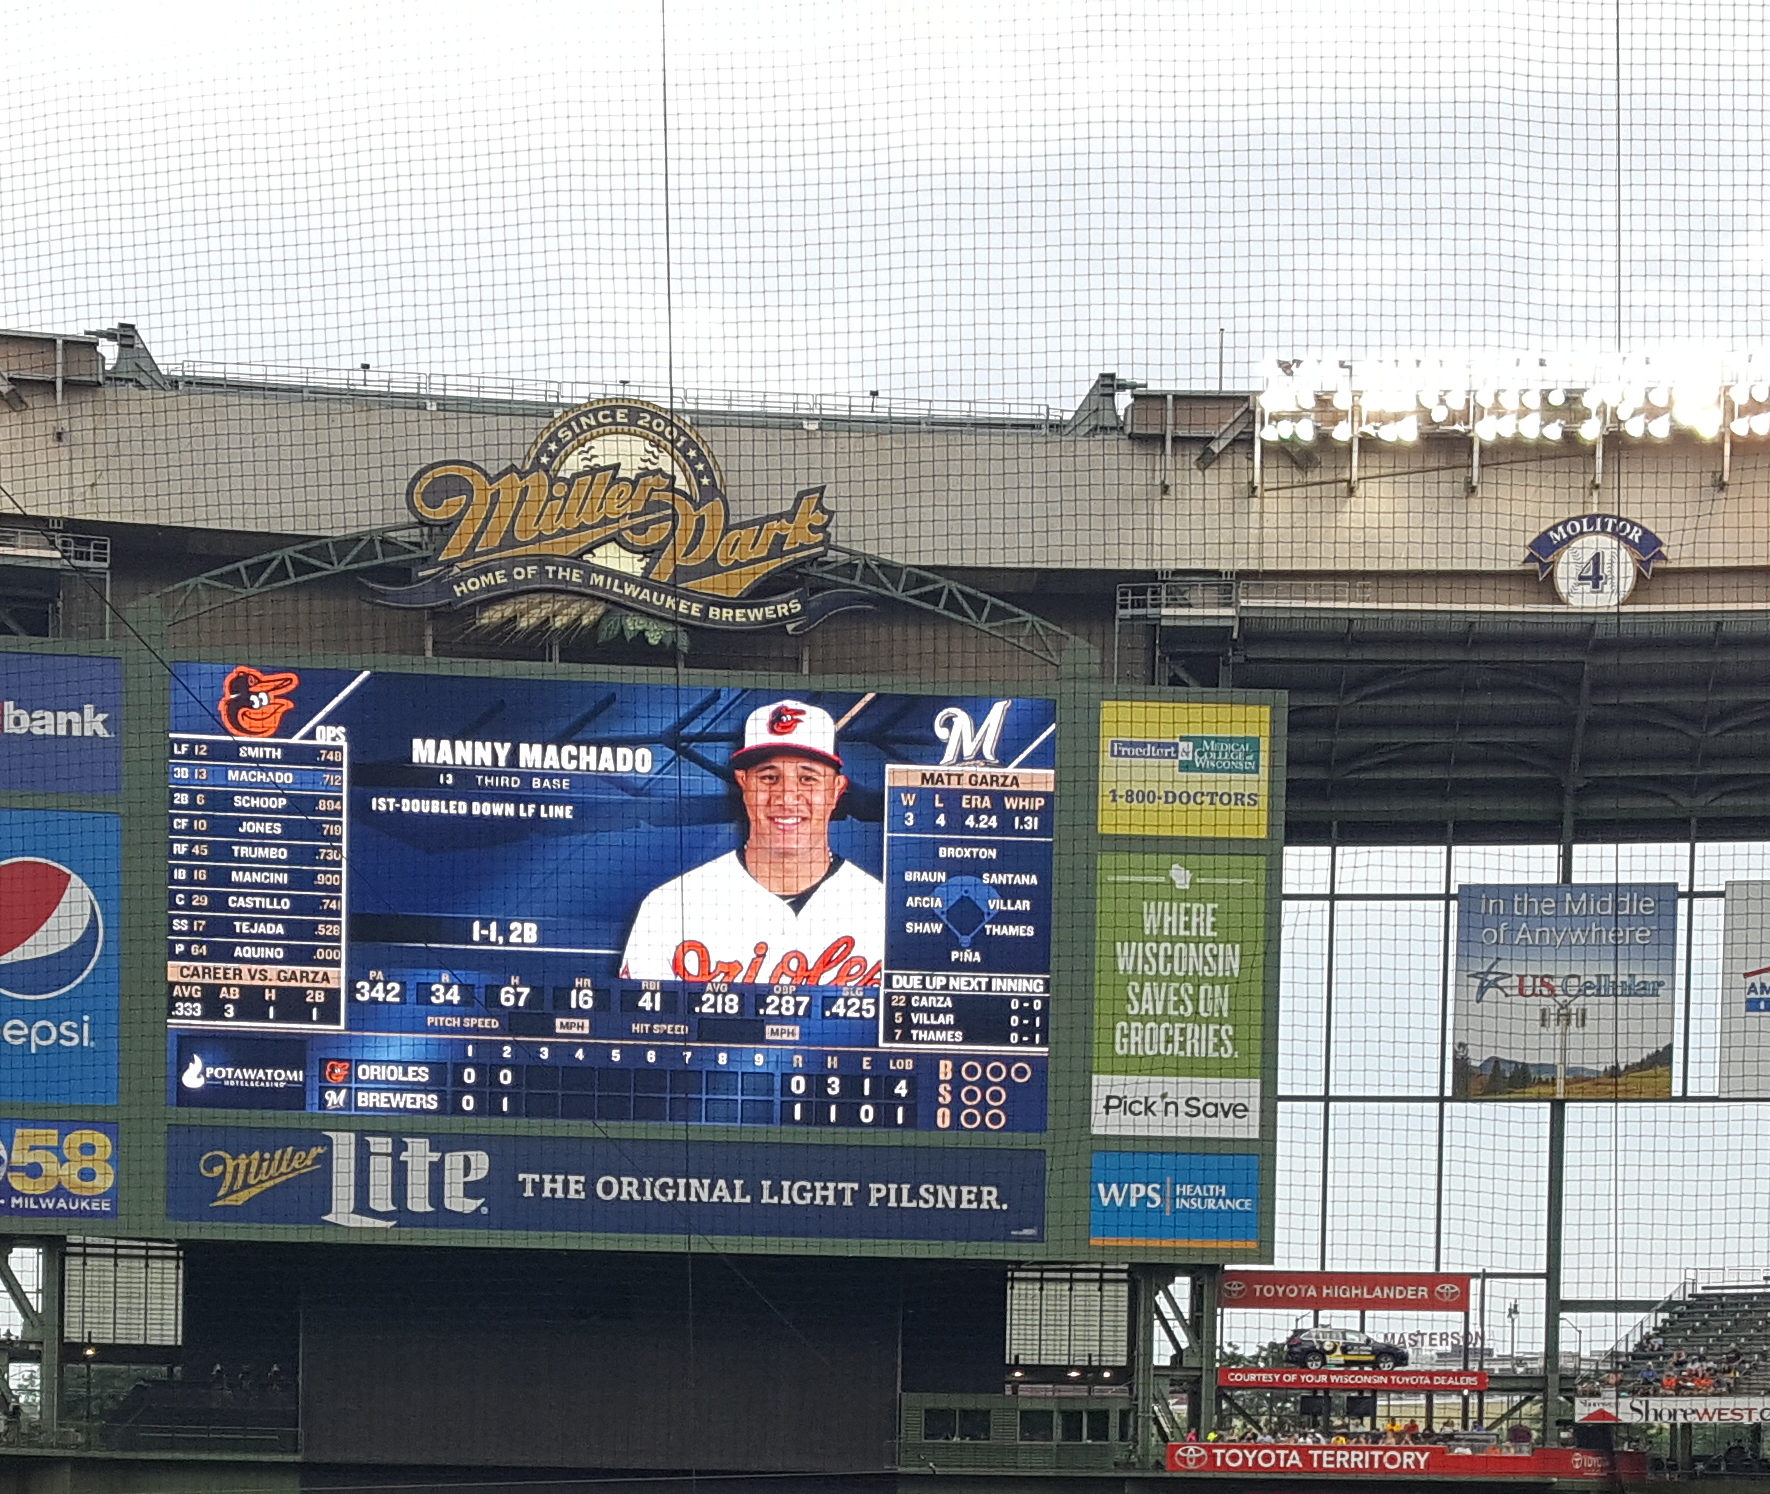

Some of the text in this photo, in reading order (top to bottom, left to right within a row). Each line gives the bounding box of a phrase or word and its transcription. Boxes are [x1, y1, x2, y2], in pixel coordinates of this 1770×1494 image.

[557, 410, 688, 446] SINCE 2001
[413, 463, 827, 598] Miller Park
[1548, 517, 1644, 545] MOLITOR
[453, 566, 802, 623] HOME OF THE MILWAUKEE BREWERS
[238, 746, 282, 759] SMITH
[412, 738, 652, 773] MANNY MACHADO
[1113, 742, 1177, 757] Froedtert
[476, 775, 570, 790] THIRD BASE
[921, 773, 1020, 788] MATT GARZA
[233, 796, 287, 809] SCHOOP
[1109, 789, 1258, 807] 1-800-DOCTORS
[231, 846, 287, 860] TRUMBO
[983, 873, 1038, 885] SANTANA
[1514, 893, 1556, 915] the
[1565, 893, 1654, 915] Middle
[1143, 901, 1218, 937] WHERE
[1482, 923, 1652, 948] of Anywhere
[233, 946, 283, 959] AQUINO
[1116, 941, 1240, 978] WISCONSIN
[1127, 983, 1229, 1018] SAVES ON
[1115, 1021, 1238, 1058] GROCERIES.
[206, 1067, 303, 1082] POTAWATOMI
[358, 1064, 429, 1082] ORIOLES
[357, 1092, 438, 1109] BREWERS
[1103, 1095, 1249, 1119] Pick Save
[7, 1128, 115, 1196] 58
[200, 1131, 1009, 1229] Miller Lite THE ORIGINAL LIGHT PILSNER.
[11, 1196, 111, 1212] MILWAUKEE
[1098, 1183, 1226, 1208] WPS HEALTH
[1176, 1198, 1252, 1210] INSURANCE
[1254, 1284, 1428, 1299] TOYOTA HIGHLANDER
[1213, 1448, 1431, 1470] TOYOTA TERRITORY
